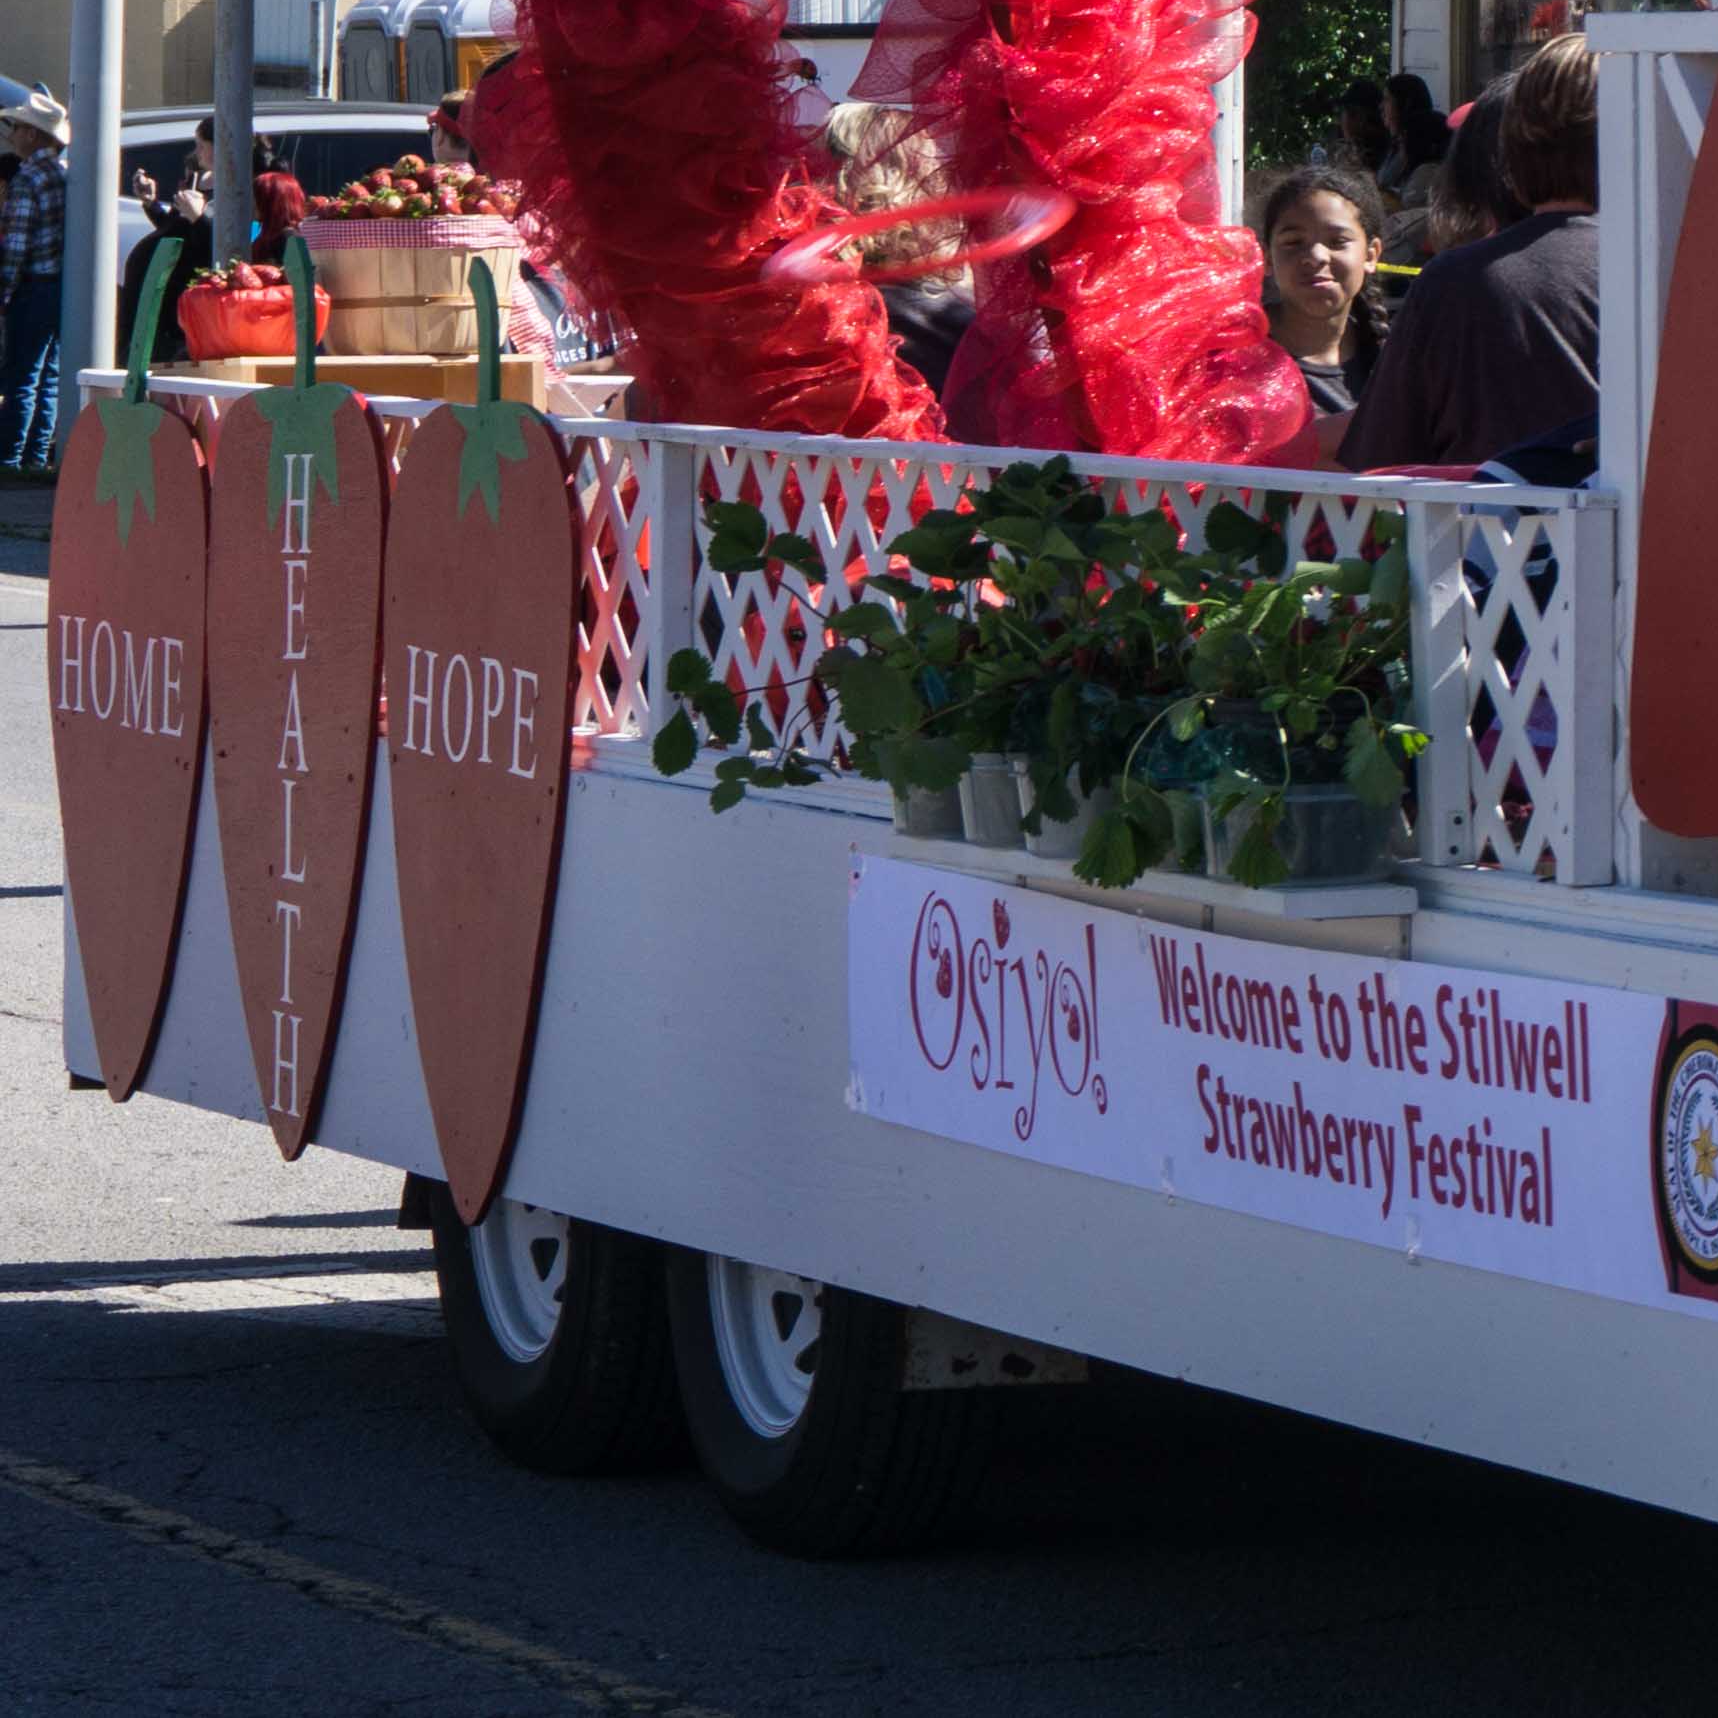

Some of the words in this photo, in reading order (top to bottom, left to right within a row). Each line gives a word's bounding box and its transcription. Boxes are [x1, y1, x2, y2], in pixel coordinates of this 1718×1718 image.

[56, 614, 185, 738] HOME
[402, 644, 540, 781] HOPE
[271, 453, 314, 1118] HEALTH
[1149, 934, 1304, 1054] Welcome
[1308, 973, 1352, 1063] to
[1358, 971, 1429, 1076] the
[1435, 984, 1592, 1104] Stilwell
[1196, 1062, 1396, 1221] Strawberry
[1403, 1103, 1554, 1227] Festival
